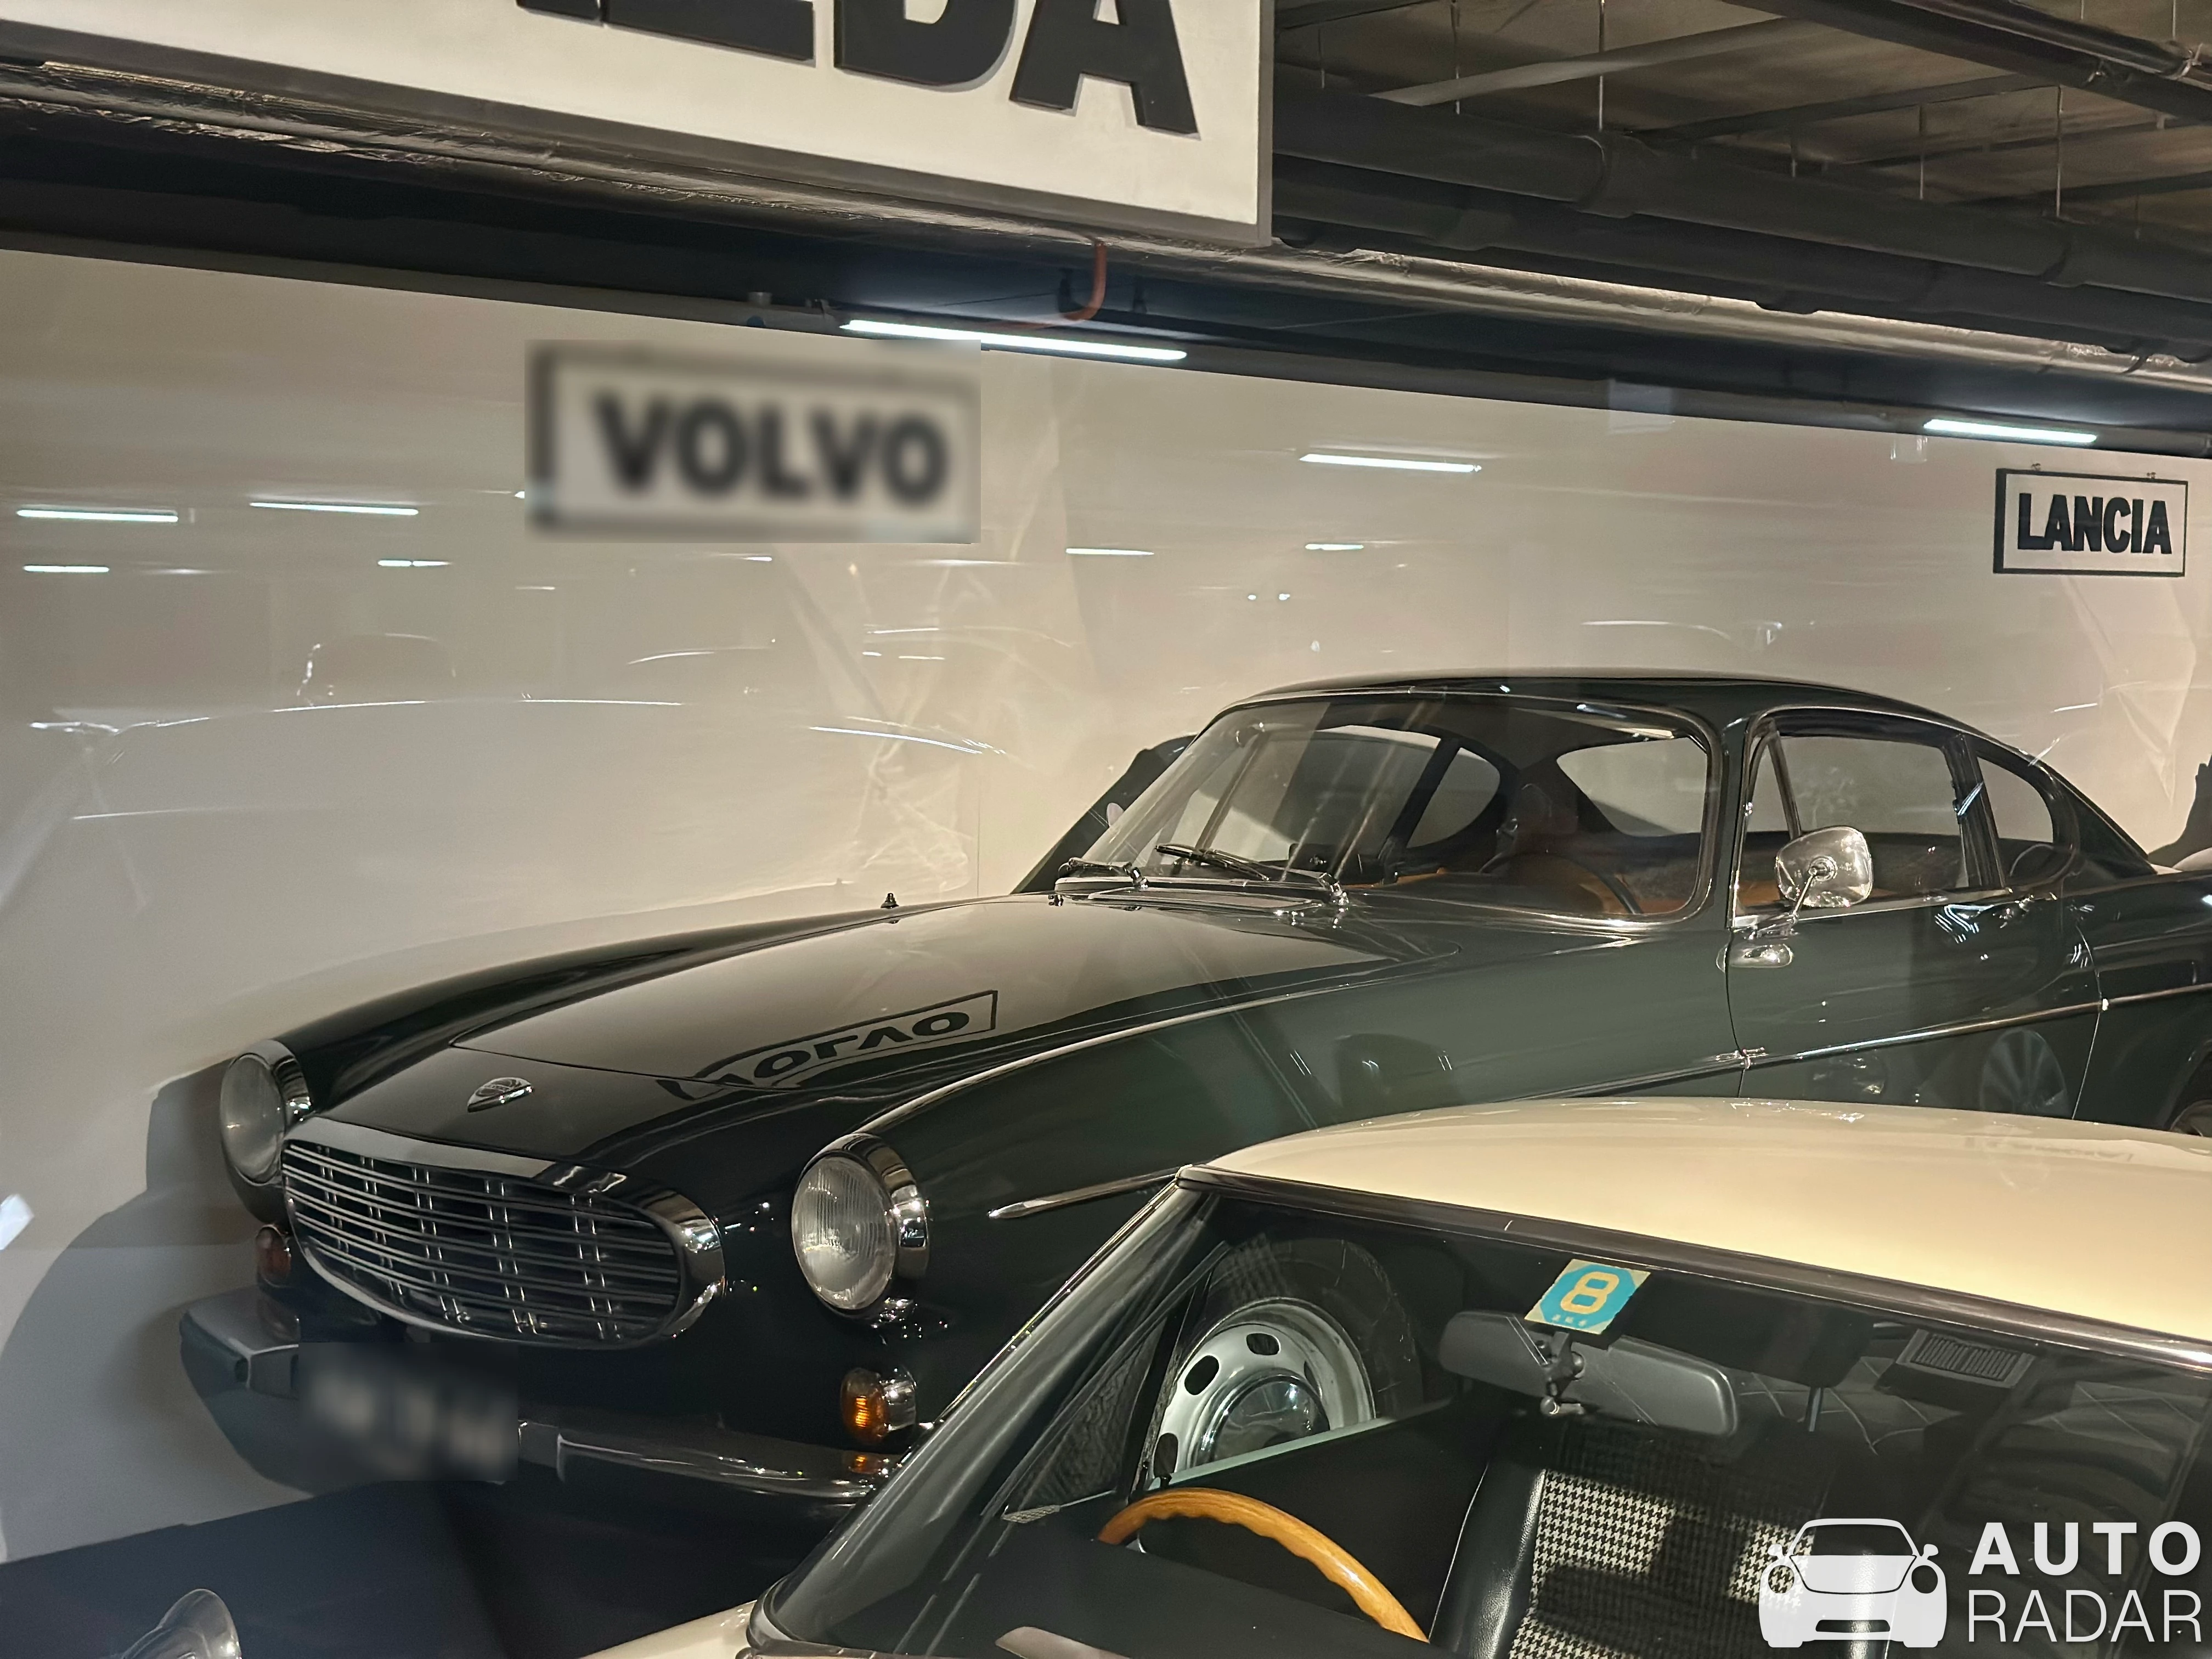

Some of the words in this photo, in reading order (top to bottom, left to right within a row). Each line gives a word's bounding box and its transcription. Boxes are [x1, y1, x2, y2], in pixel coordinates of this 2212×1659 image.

[592, 390, 949, 510] VOLVO
[2017, 493, 2172, 554] LANCIA
[1560, 1271, 1620, 1314] 8
